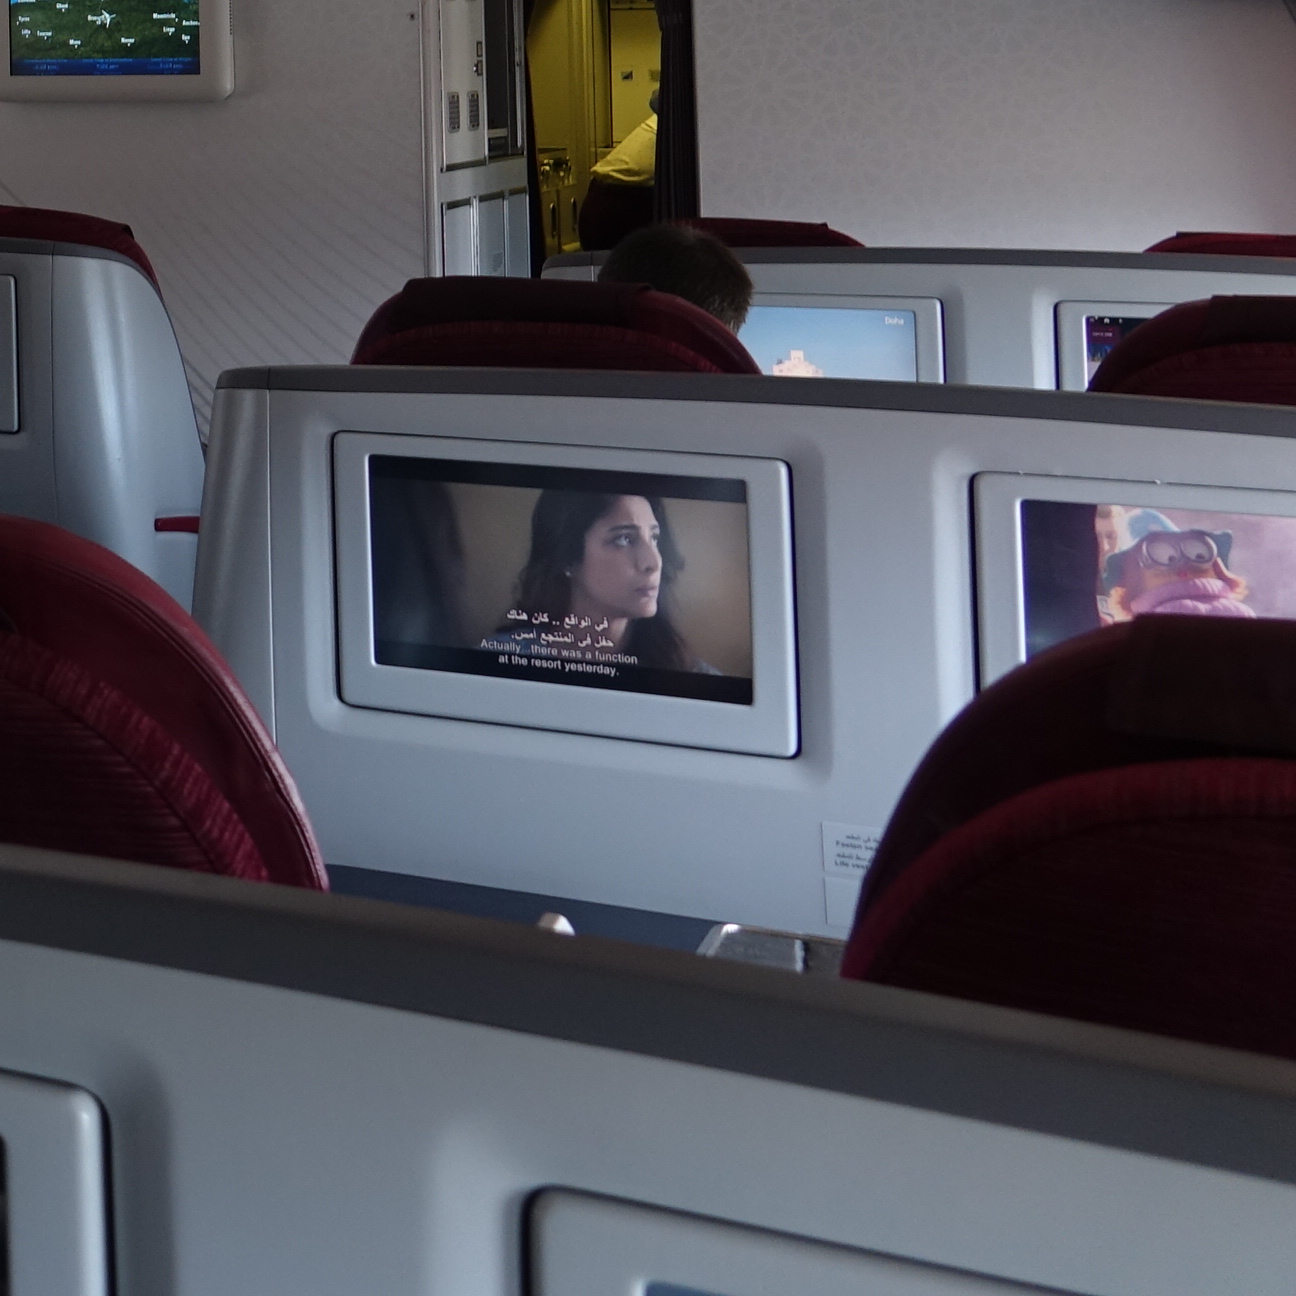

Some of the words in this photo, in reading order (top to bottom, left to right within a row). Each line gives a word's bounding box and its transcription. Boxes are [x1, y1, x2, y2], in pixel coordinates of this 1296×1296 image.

[498, 655, 509, 664] at
[511, 655, 528, 666] the
[531, 658, 561, 670] resort
[564, 662, 619, 677] yesterday.
[561, 648, 581, 658] was
[585, 651, 592, 659] a
[595, 649, 638, 665] function
